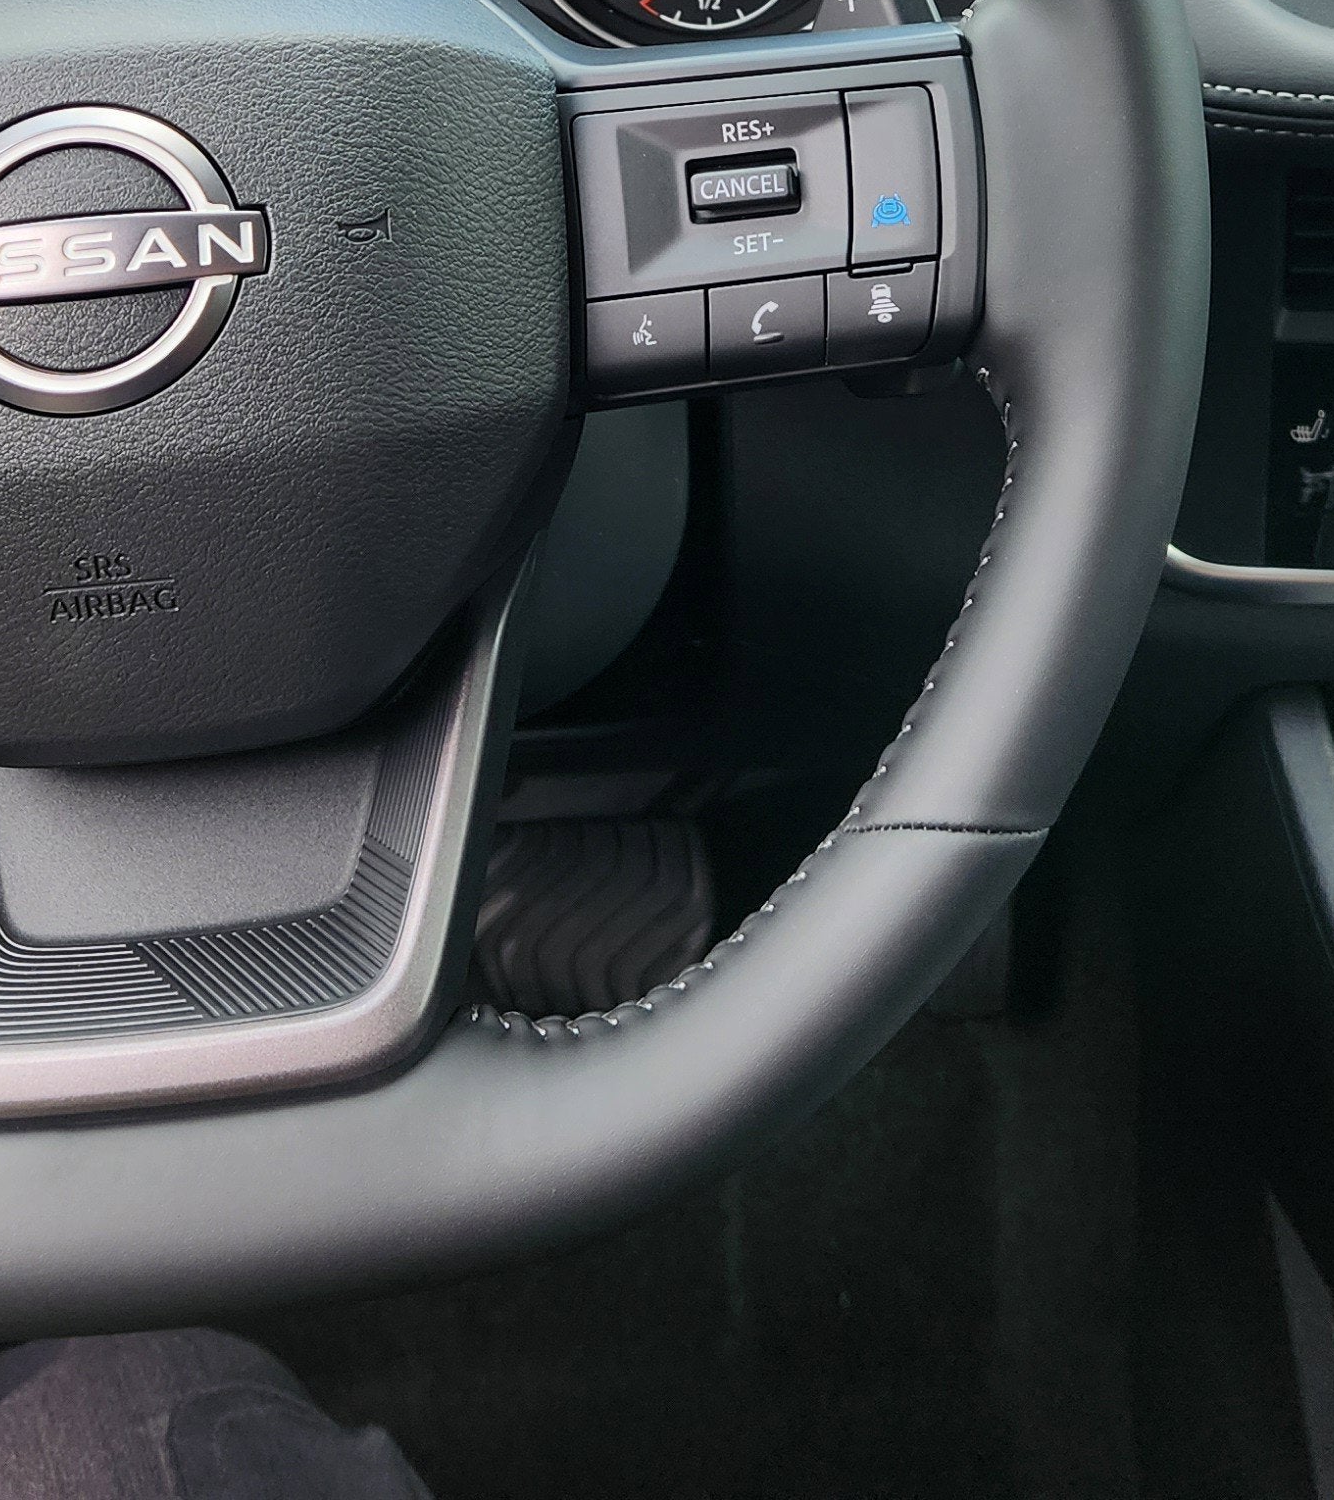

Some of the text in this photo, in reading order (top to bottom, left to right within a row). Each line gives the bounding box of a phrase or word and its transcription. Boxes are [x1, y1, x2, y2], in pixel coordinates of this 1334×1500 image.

[721, 119, 775, 143] RES+
[700, 174, 785, 201] CANCEL
[74, 553, 133, 582] SRS
[47, 586, 180, 623] AIRBAG
